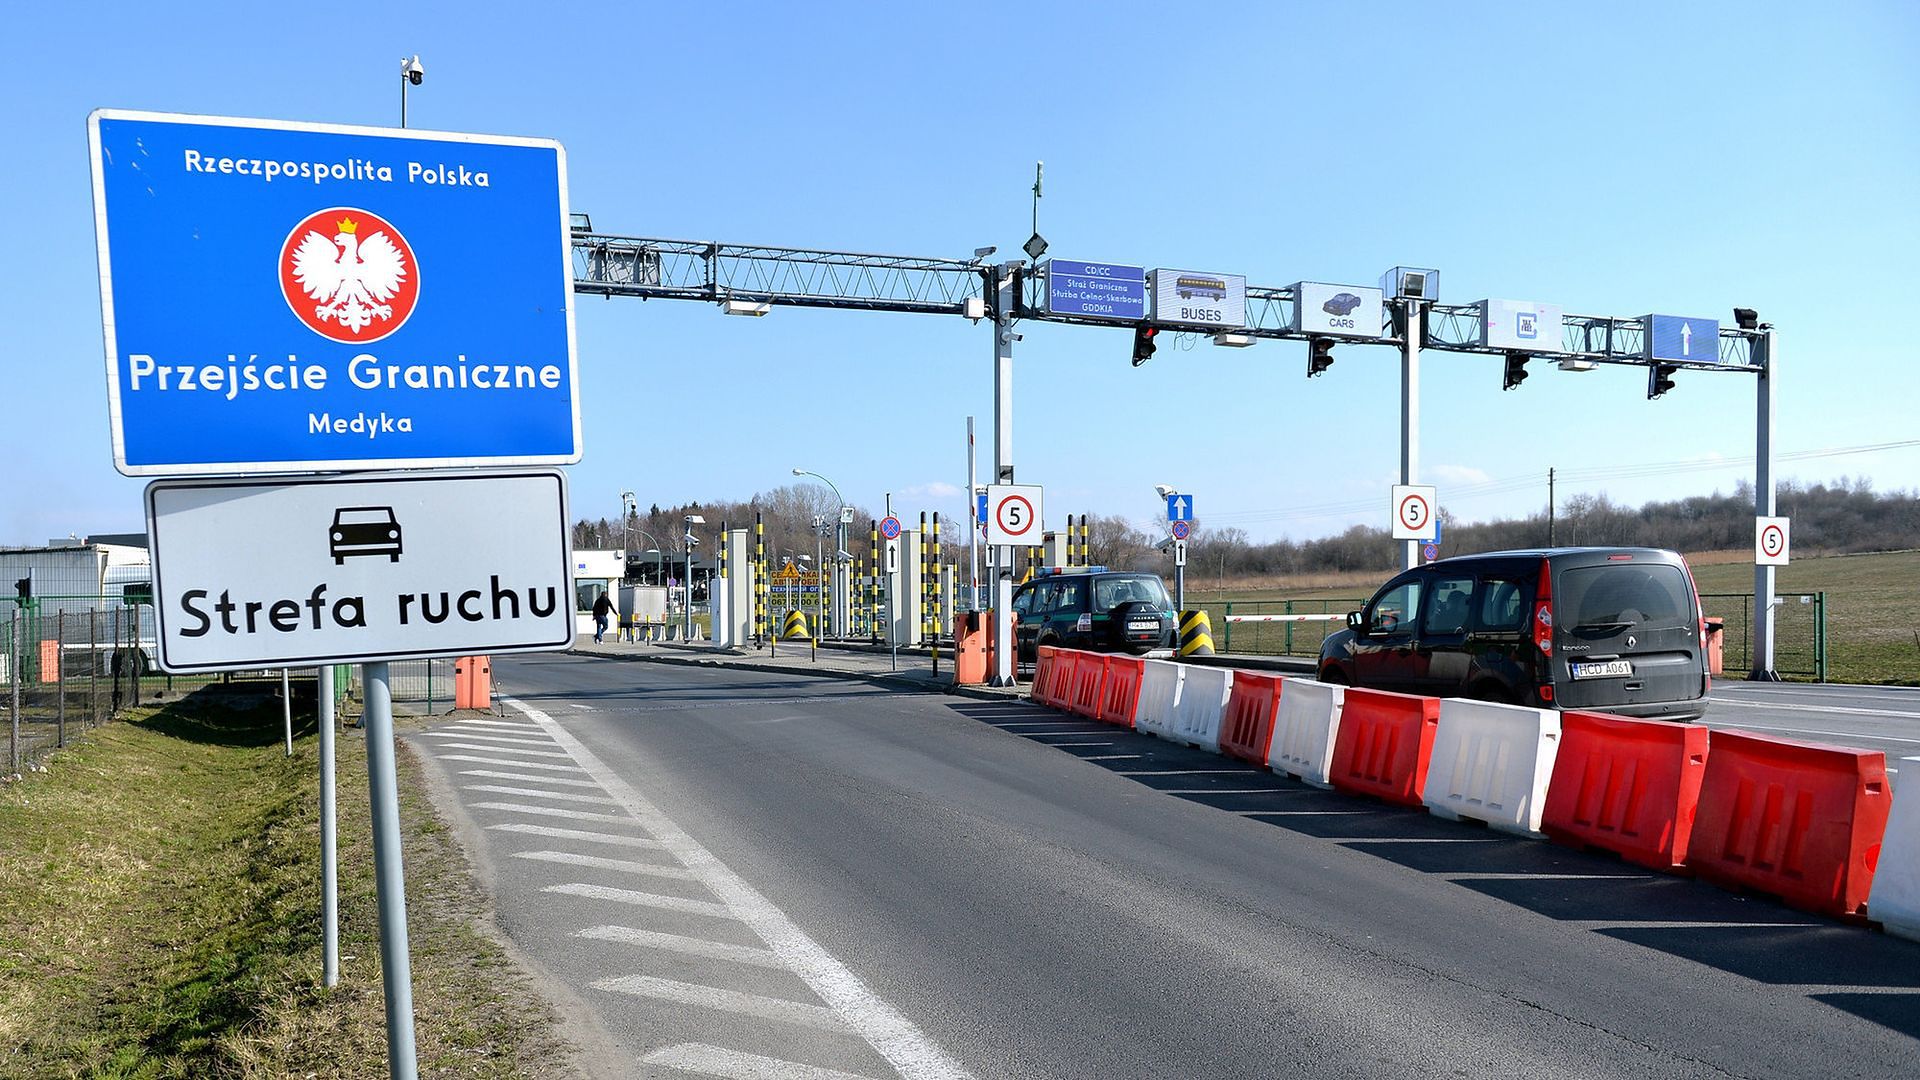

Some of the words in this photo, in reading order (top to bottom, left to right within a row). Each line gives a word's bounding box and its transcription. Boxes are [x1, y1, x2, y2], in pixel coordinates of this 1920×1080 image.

[185, 149, 393, 185] Rzeczpospolita
[408, 162, 489, 187] Polska
[1052, 289, 1078, 298] Służba
[1089, 281, 1128, 292] Graniczna
[1181, 307, 1221, 322] BUSES
[1329, 318, 1354, 329] CARS
[130, 354, 327, 401] Przejście
[348, 354, 561, 390] Graniczne
[309, 412, 413, 439] Medyka
[1009, 506, 1020, 526] 5
[1409, 504, 1419, 521] 5
[1769, 534, 1776, 549] 5
[179, 583, 367, 638] Strefa
[398, 574, 556, 625] ruchu
[1579, 663, 1602, 676] HCD
[1606, 662, 1630, 675] A061
